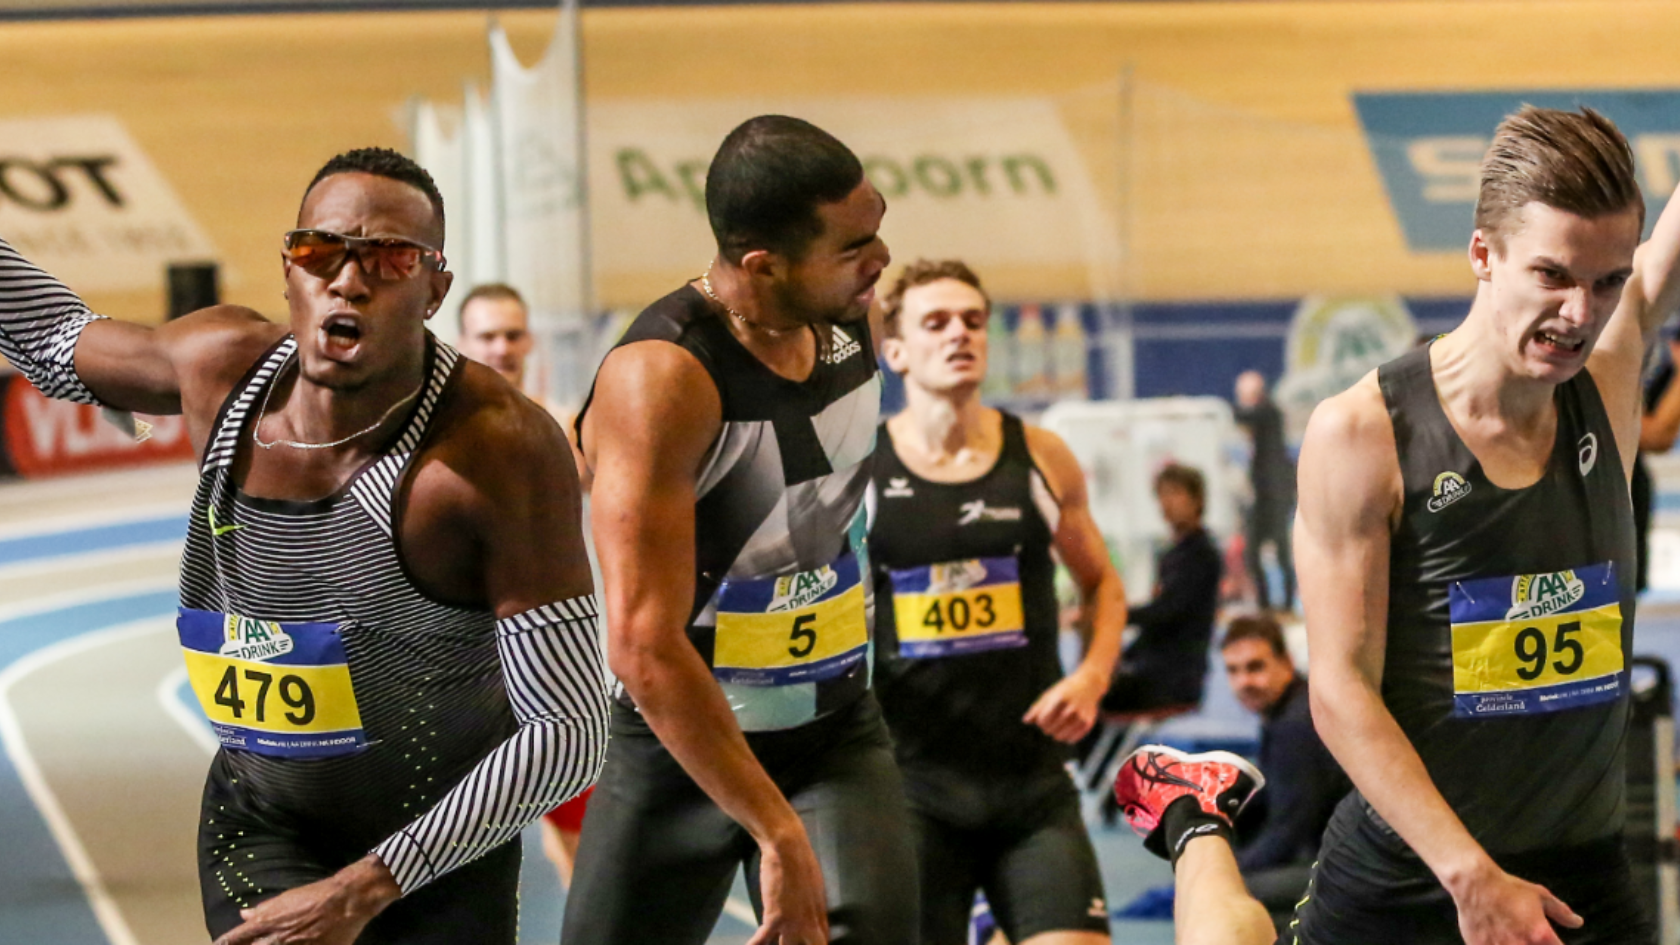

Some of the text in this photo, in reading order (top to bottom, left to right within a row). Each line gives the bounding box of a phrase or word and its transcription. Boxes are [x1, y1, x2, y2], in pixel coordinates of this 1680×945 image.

[788, 580, 830, 609] DRINK
[795, 571, 820, 596] AA
[1536, 573, 1567, 602] AA
[922, 594, 996, 633] 403
[1531, 591, 1576, 617] DRINK
[245, 619, 271, 644] AA
[788, 613, 817, 658] 5
[241, 641, 280, 659] DRINK
[1514, 621, 1584, 681] 95
[214, 665, 316, 726] 479
